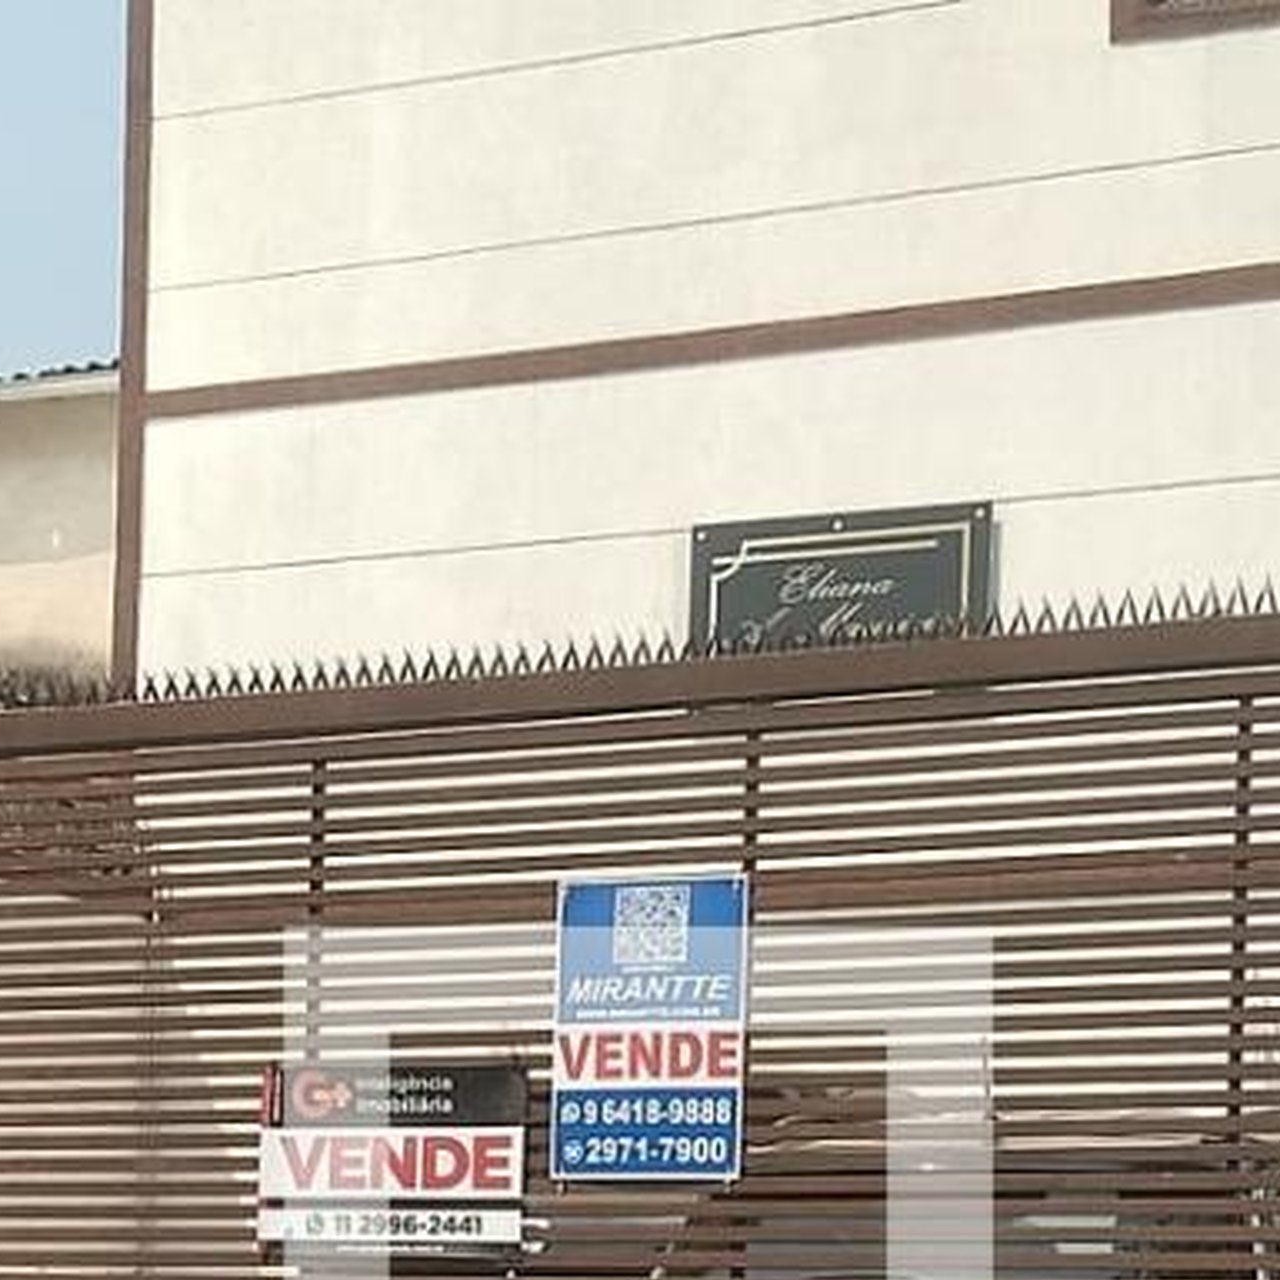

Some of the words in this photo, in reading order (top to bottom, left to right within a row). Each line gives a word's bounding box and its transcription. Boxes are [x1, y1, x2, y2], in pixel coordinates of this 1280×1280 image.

[566, 973, 732, 1005] MIRANTTE
[558, 1030, 740, 1080] VENDE
[278, 1135, 514, 1190] VENDE
[585, 1136, 729, 1165] 2971-7900
[334, 1215, 352, 1234] 11
[358, 1214, 483, 1235] 2996-2441
